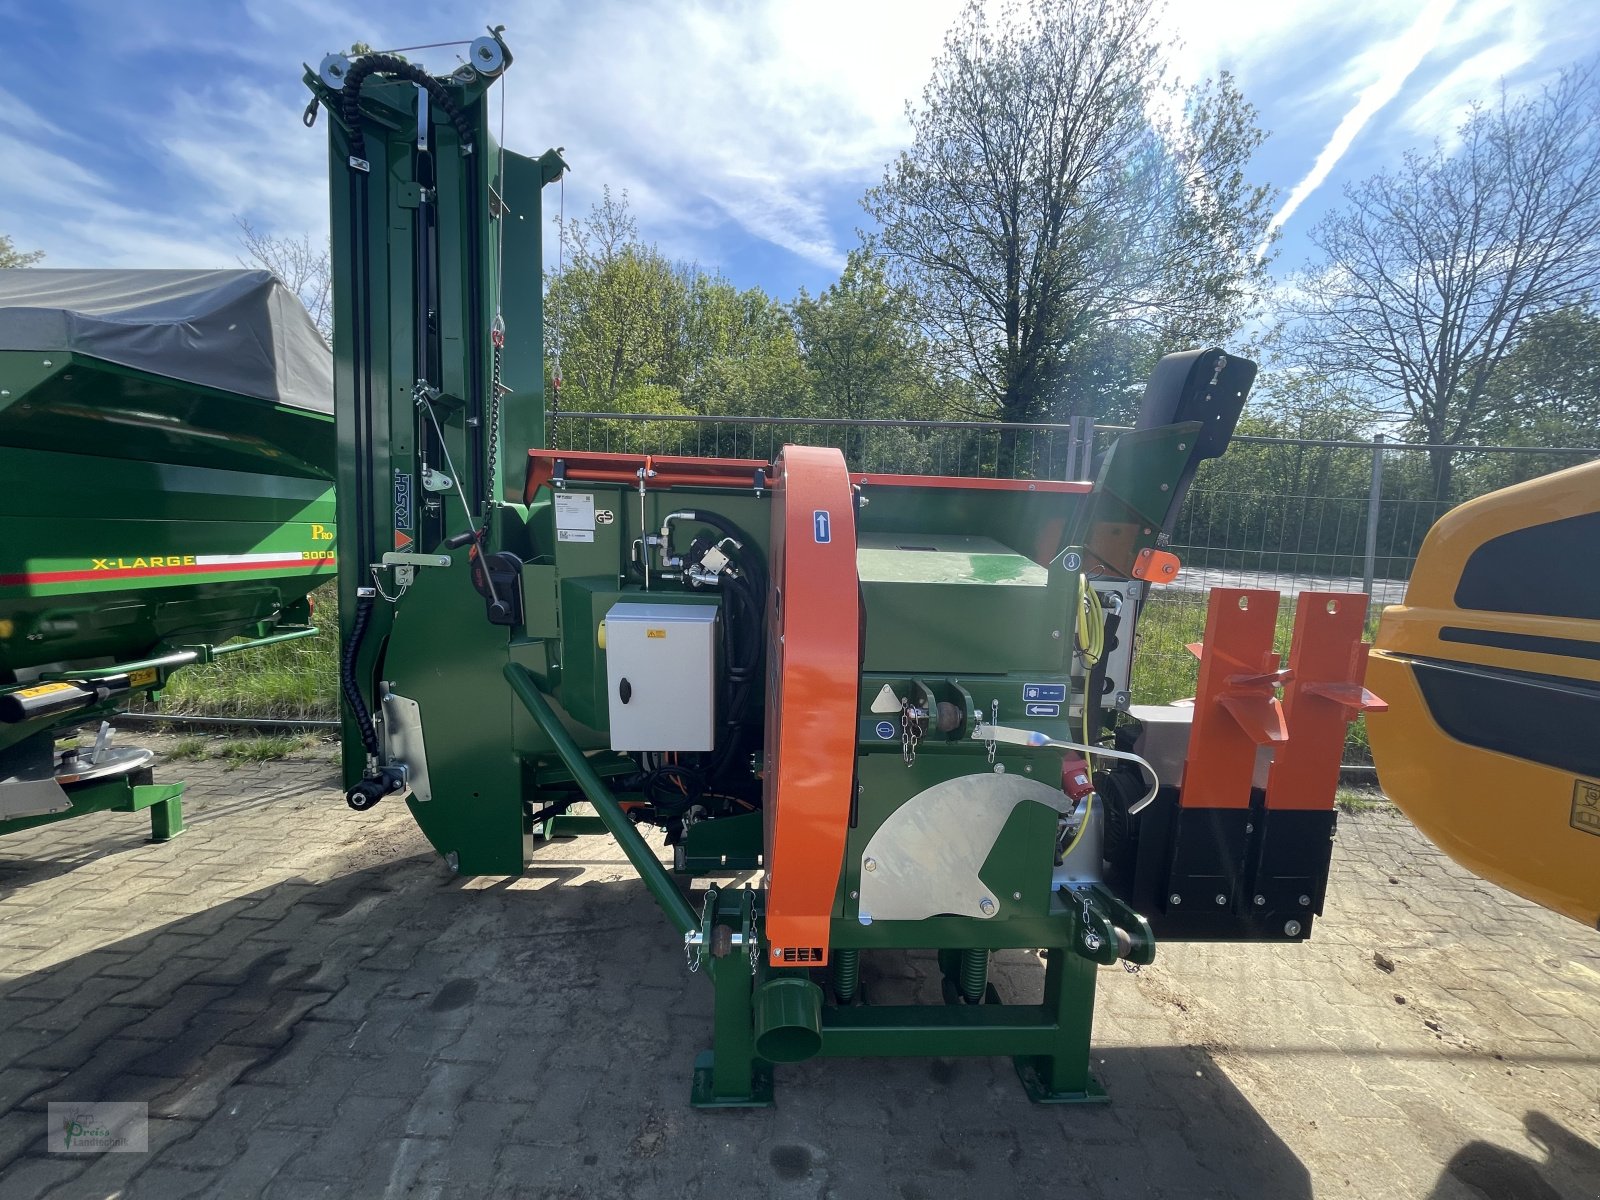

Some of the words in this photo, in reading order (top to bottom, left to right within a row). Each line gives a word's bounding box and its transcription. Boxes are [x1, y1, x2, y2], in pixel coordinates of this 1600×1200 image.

[395, 474, 410, 529] POSCH
[596, 511, 613, 523] GS
[303, 551, 334, 560] 3000
[92, 555, 197, 570] X-LARGE
